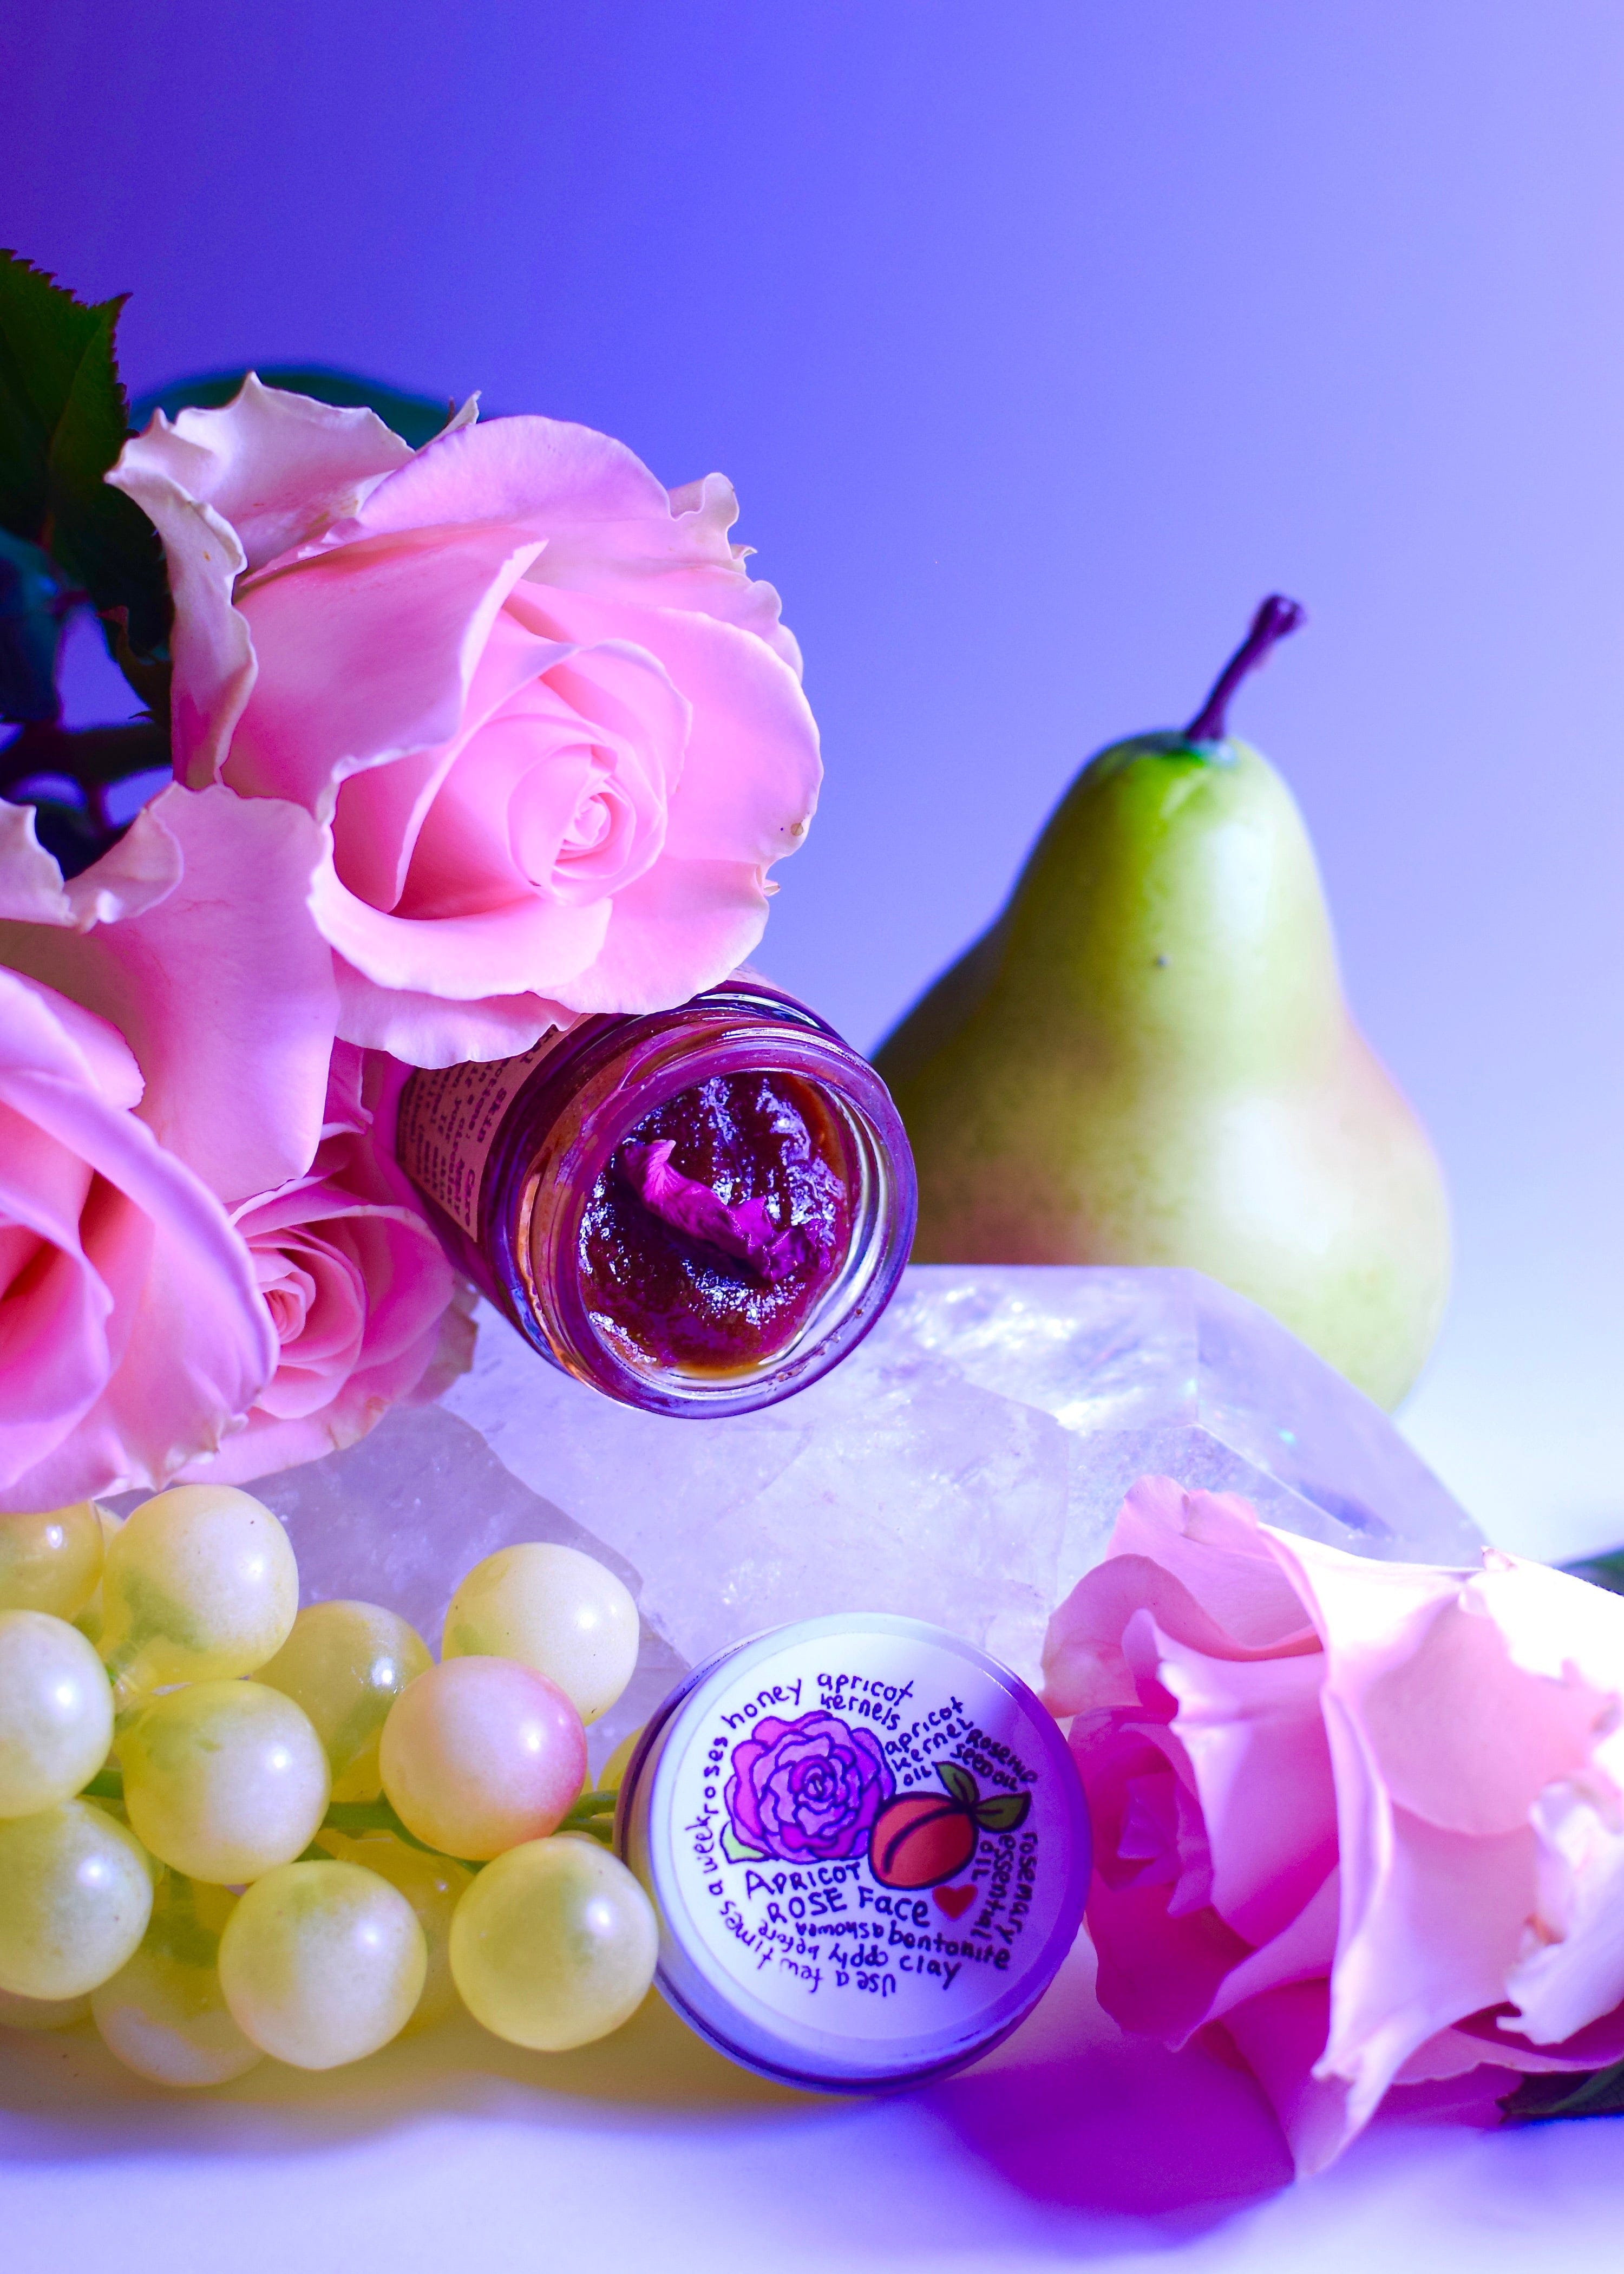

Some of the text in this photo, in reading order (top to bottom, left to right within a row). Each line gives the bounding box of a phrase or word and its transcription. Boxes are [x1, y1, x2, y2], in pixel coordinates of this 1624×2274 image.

[477, 1088, 507, 1143] Skin
[447, 1118, 465, 1205] circular
[464, 1169, 475, 1226] Care
[721, 1678, 801, 1729] honey
[817, 1673, 914, 1706] apricot
[821, 1693, 900, 1731] kernels
[885, 1696, 964, 1755] apricot
[891, 1717, 974, 1772] kernel
[703, 1737, 728, 1814] roses
[684, 1816, 896, 1997] Use a few times a week
[745, 1861, 861, 1901] APRICOT
[767, 1886, 930, 1927] ROSE Face
[971, 1834, 1016, 1939] essential
[994, 1831, 1038, 1945] rosemary
[758, 1919, 888, 1969] apply before
[888, 1919, 1010, 1970] bentonite
[900, 1955, 962, 1990] clay
